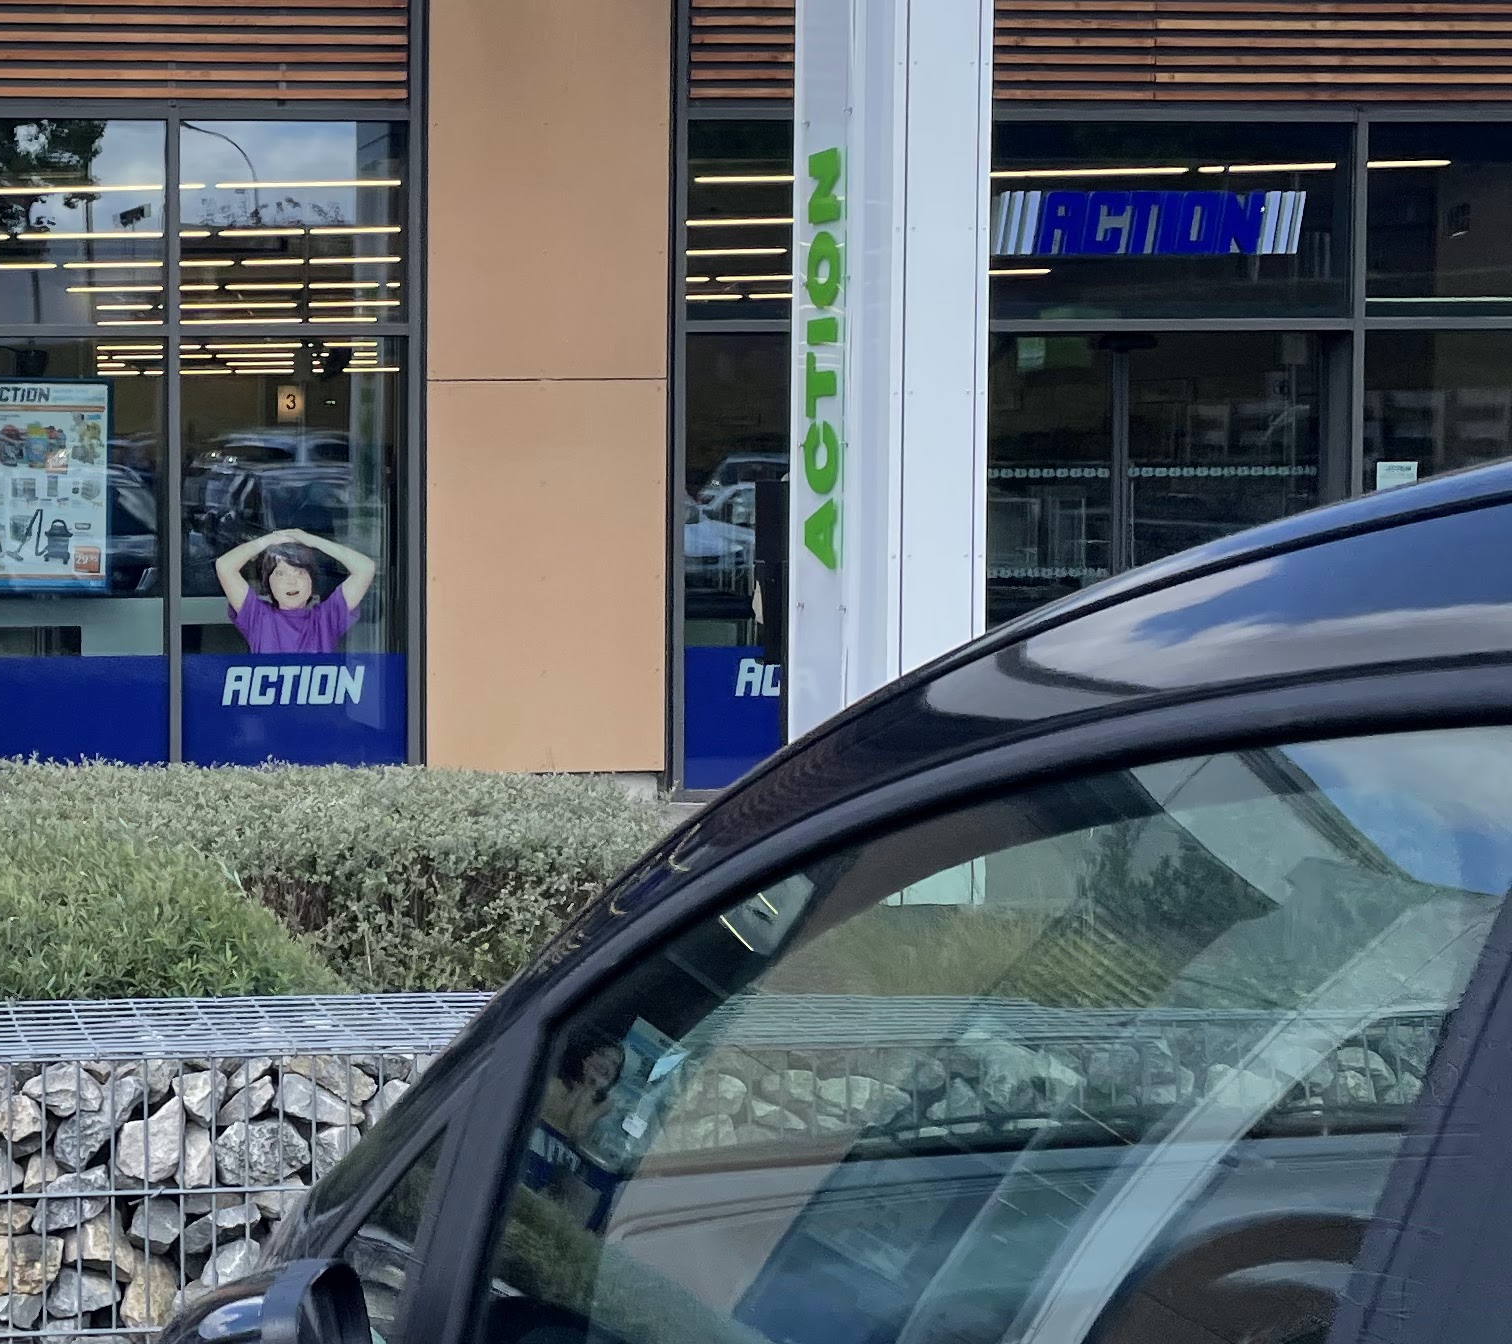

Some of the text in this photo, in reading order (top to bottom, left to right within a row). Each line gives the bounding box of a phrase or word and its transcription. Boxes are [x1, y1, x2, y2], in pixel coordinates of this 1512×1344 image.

[1038, 190, 1267, 255] ACTION
[804, 147, 841, 570] ACTION
[285, 393, 297, 410] 3
[221, 665, 366, 706] ACTION
[734, 657, 782, 697] AC
